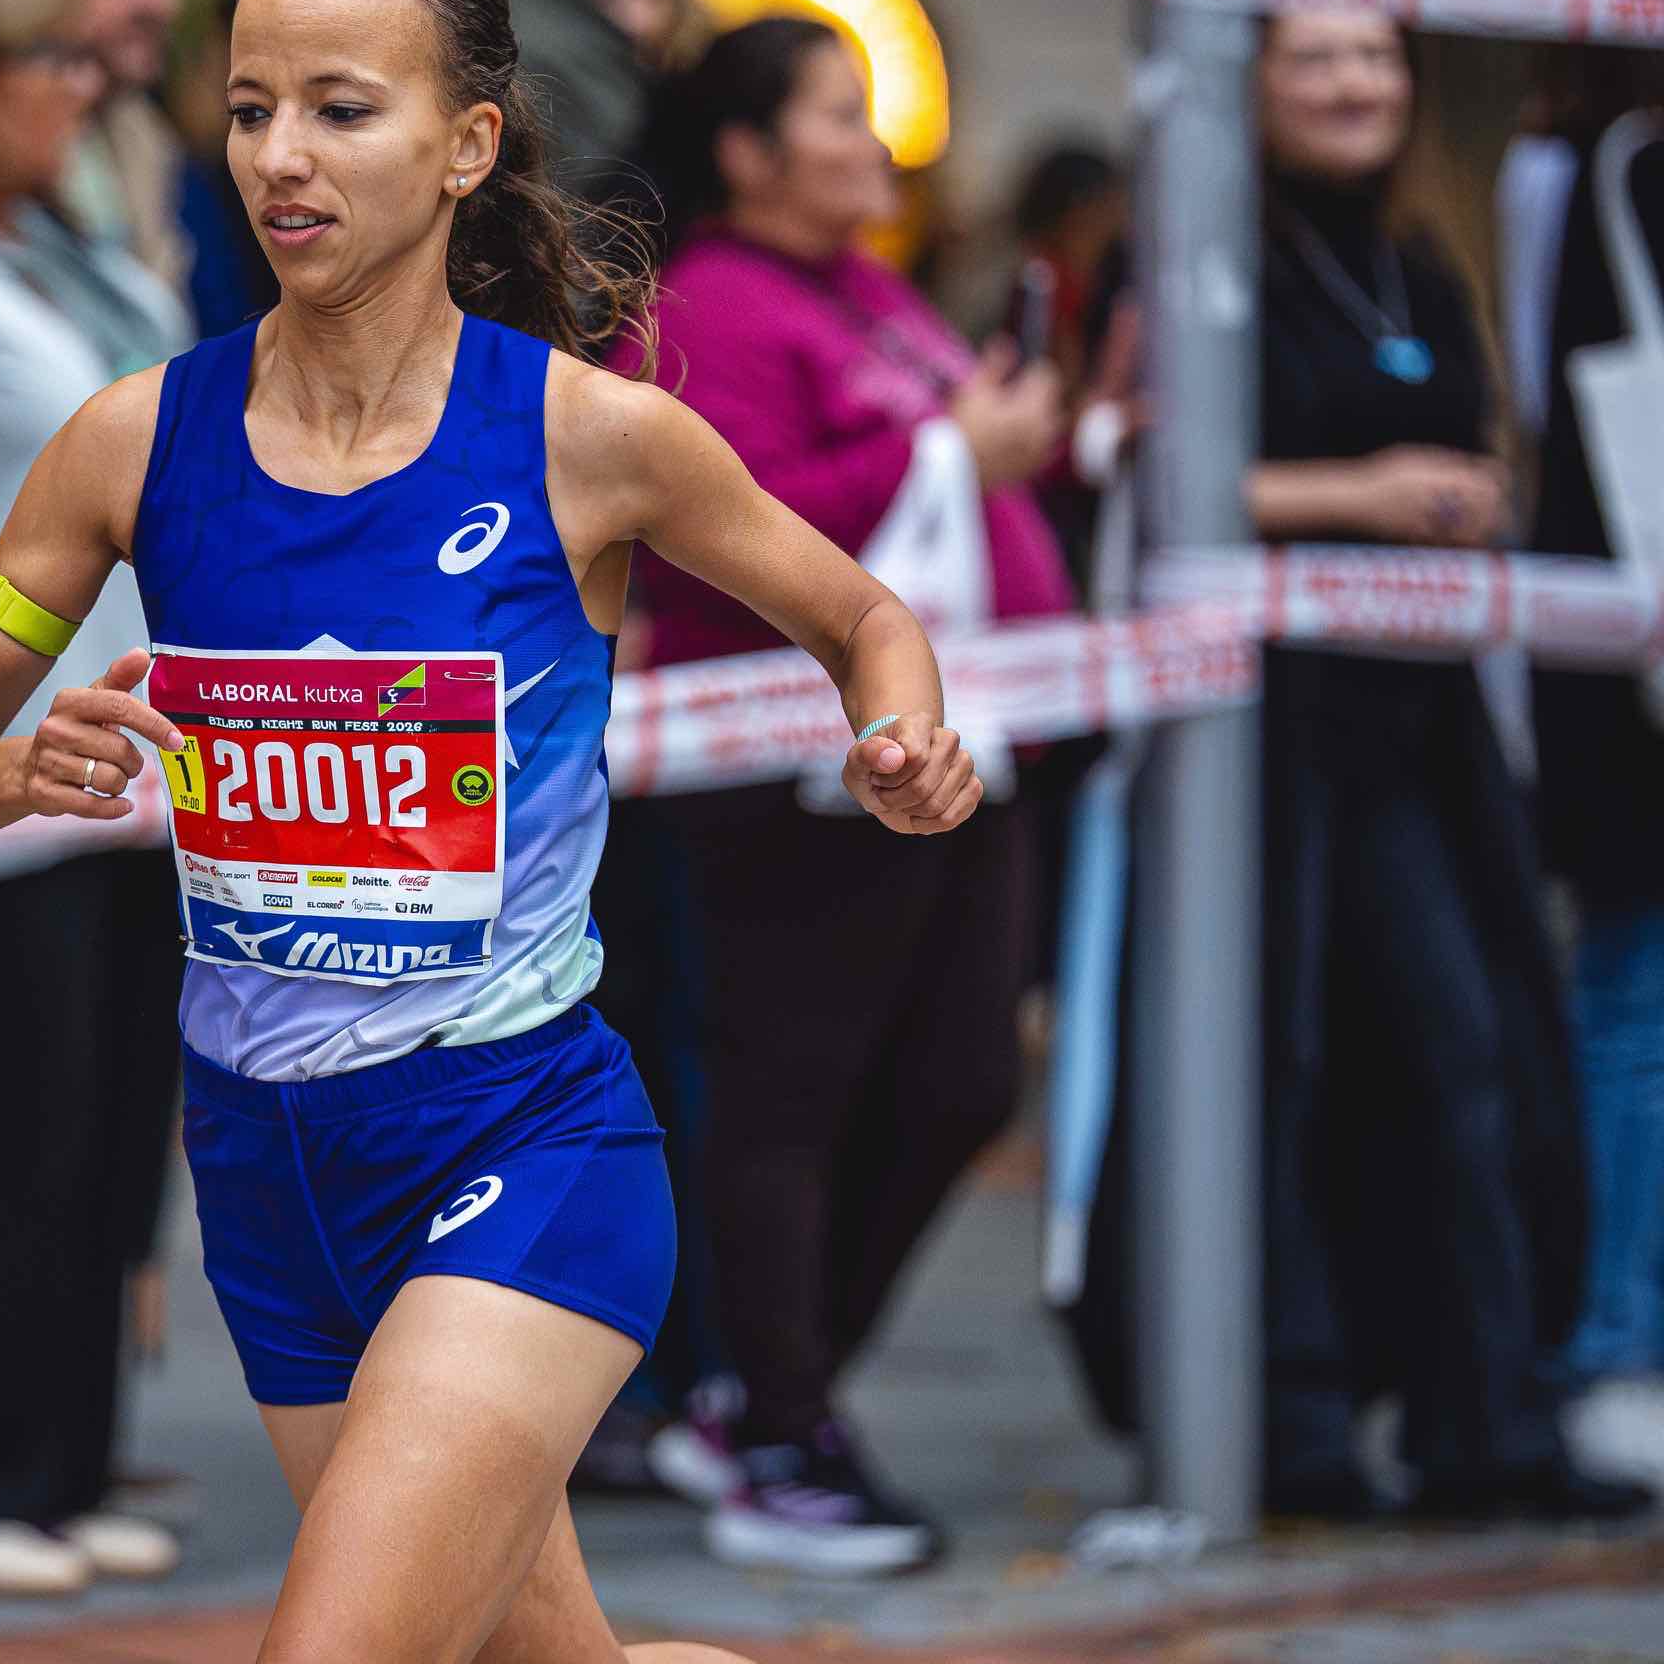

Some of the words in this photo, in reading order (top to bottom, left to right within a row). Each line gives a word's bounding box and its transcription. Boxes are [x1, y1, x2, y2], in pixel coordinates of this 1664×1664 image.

[199, 683, 298, 703] LABORAL
[304, 686, 363, 703] kutxa
[208, 716, 253, 729] BILBAO
[262, 719, 304, 730] NIGHT
[312, 720, 337, 731] RUN
[344, 721, 379, 732] FEST
[386, 721, 423, 733] 2026
[175, 754, 192, 793] 1
[213, 739, 427, 828] 20012
[268, 872, 297, 883] ENERVIT
[352, 875, 392, 887] Deloitte.
[264, 896, 291, 907] GOYA
[307, 901, 316, 909] EL
[316, 901, 343, 910] CORREO
[410, 903, 434, 915] BM
